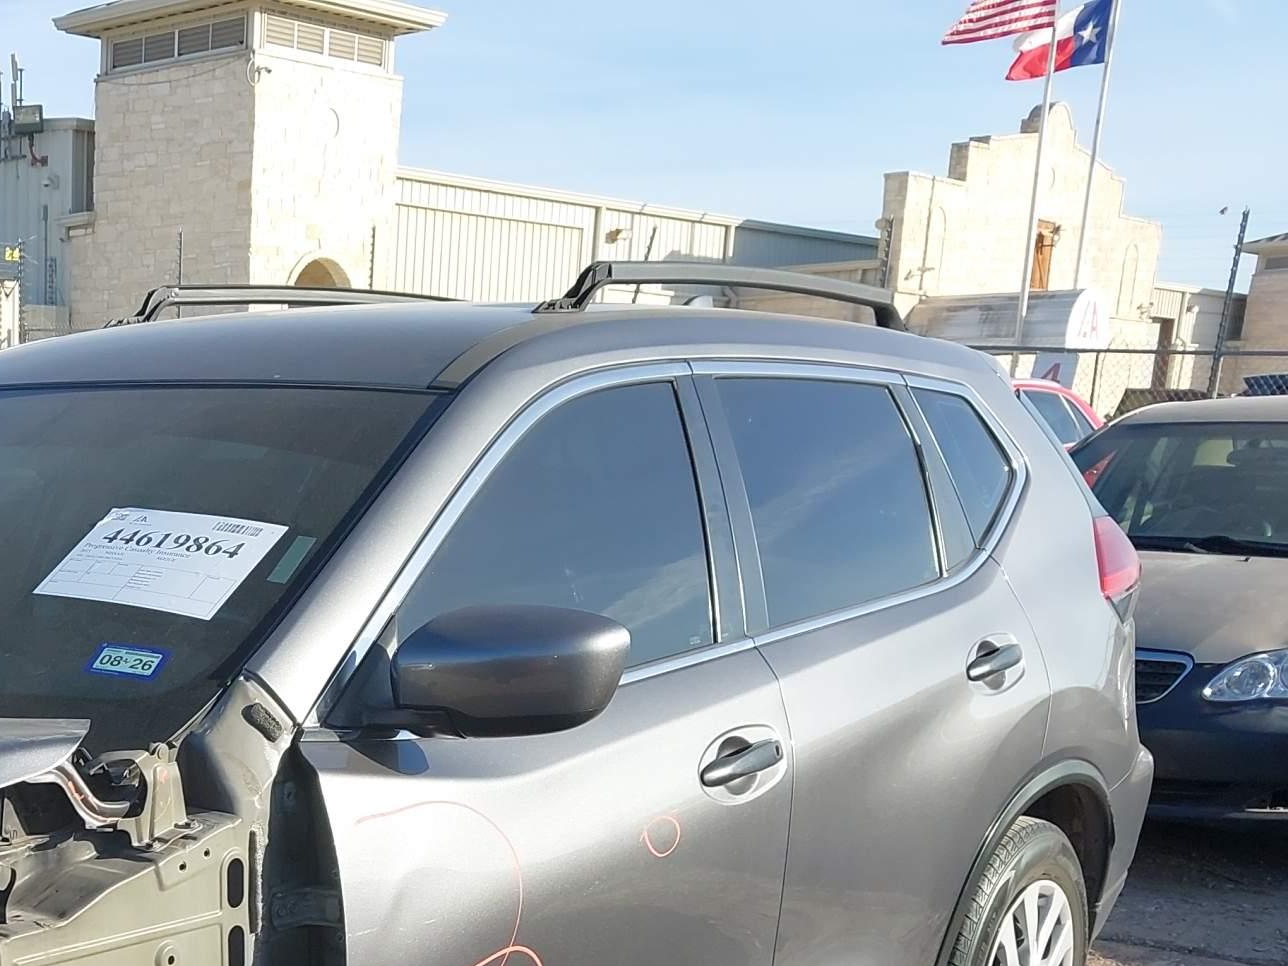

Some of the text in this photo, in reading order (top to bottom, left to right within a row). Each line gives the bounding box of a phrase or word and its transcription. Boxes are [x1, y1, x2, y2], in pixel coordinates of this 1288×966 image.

[102, 527, 246, 559] 44619864
[99, 654, 155, 671] 08 26
